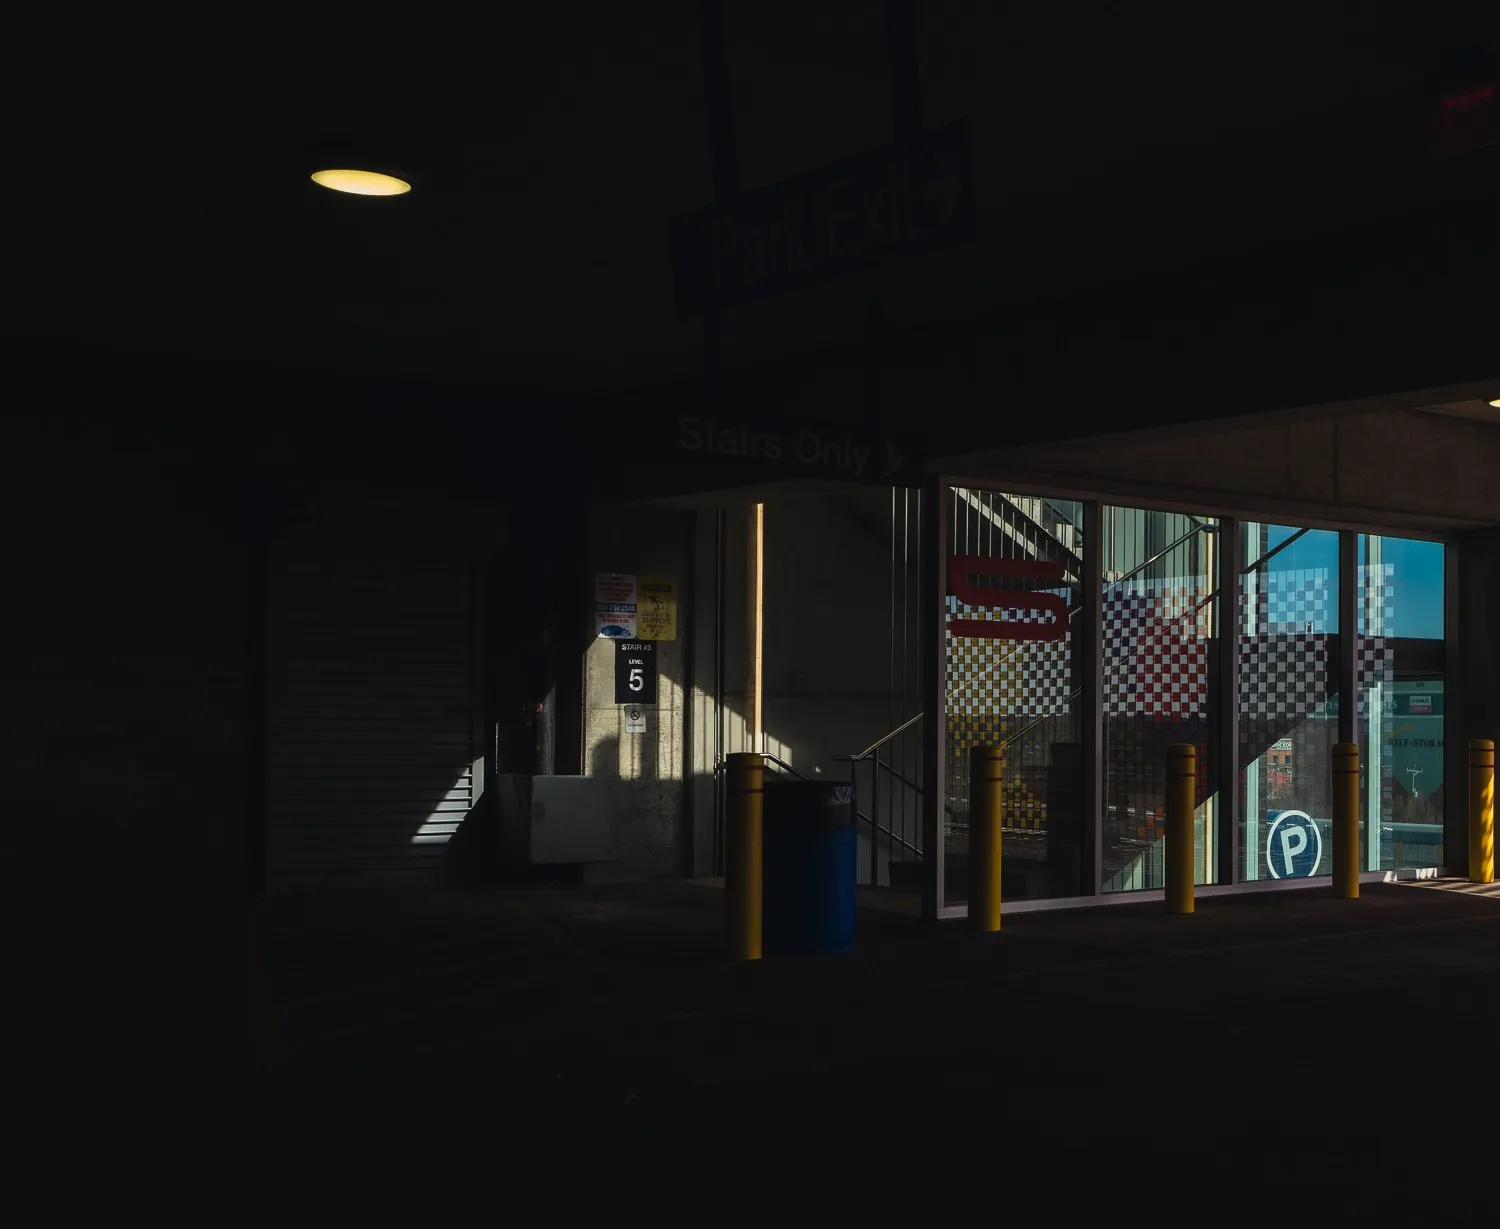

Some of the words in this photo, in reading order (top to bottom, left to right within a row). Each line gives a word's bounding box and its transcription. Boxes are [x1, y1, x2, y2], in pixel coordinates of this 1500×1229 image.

[678, 414, 782, 459] Stairs
[793, 430, 870, 477] Only
[621, 643, 642, 651] STAIR
[629, 668, 644, 691] 5
[1280, 825, 1307, 875] P
